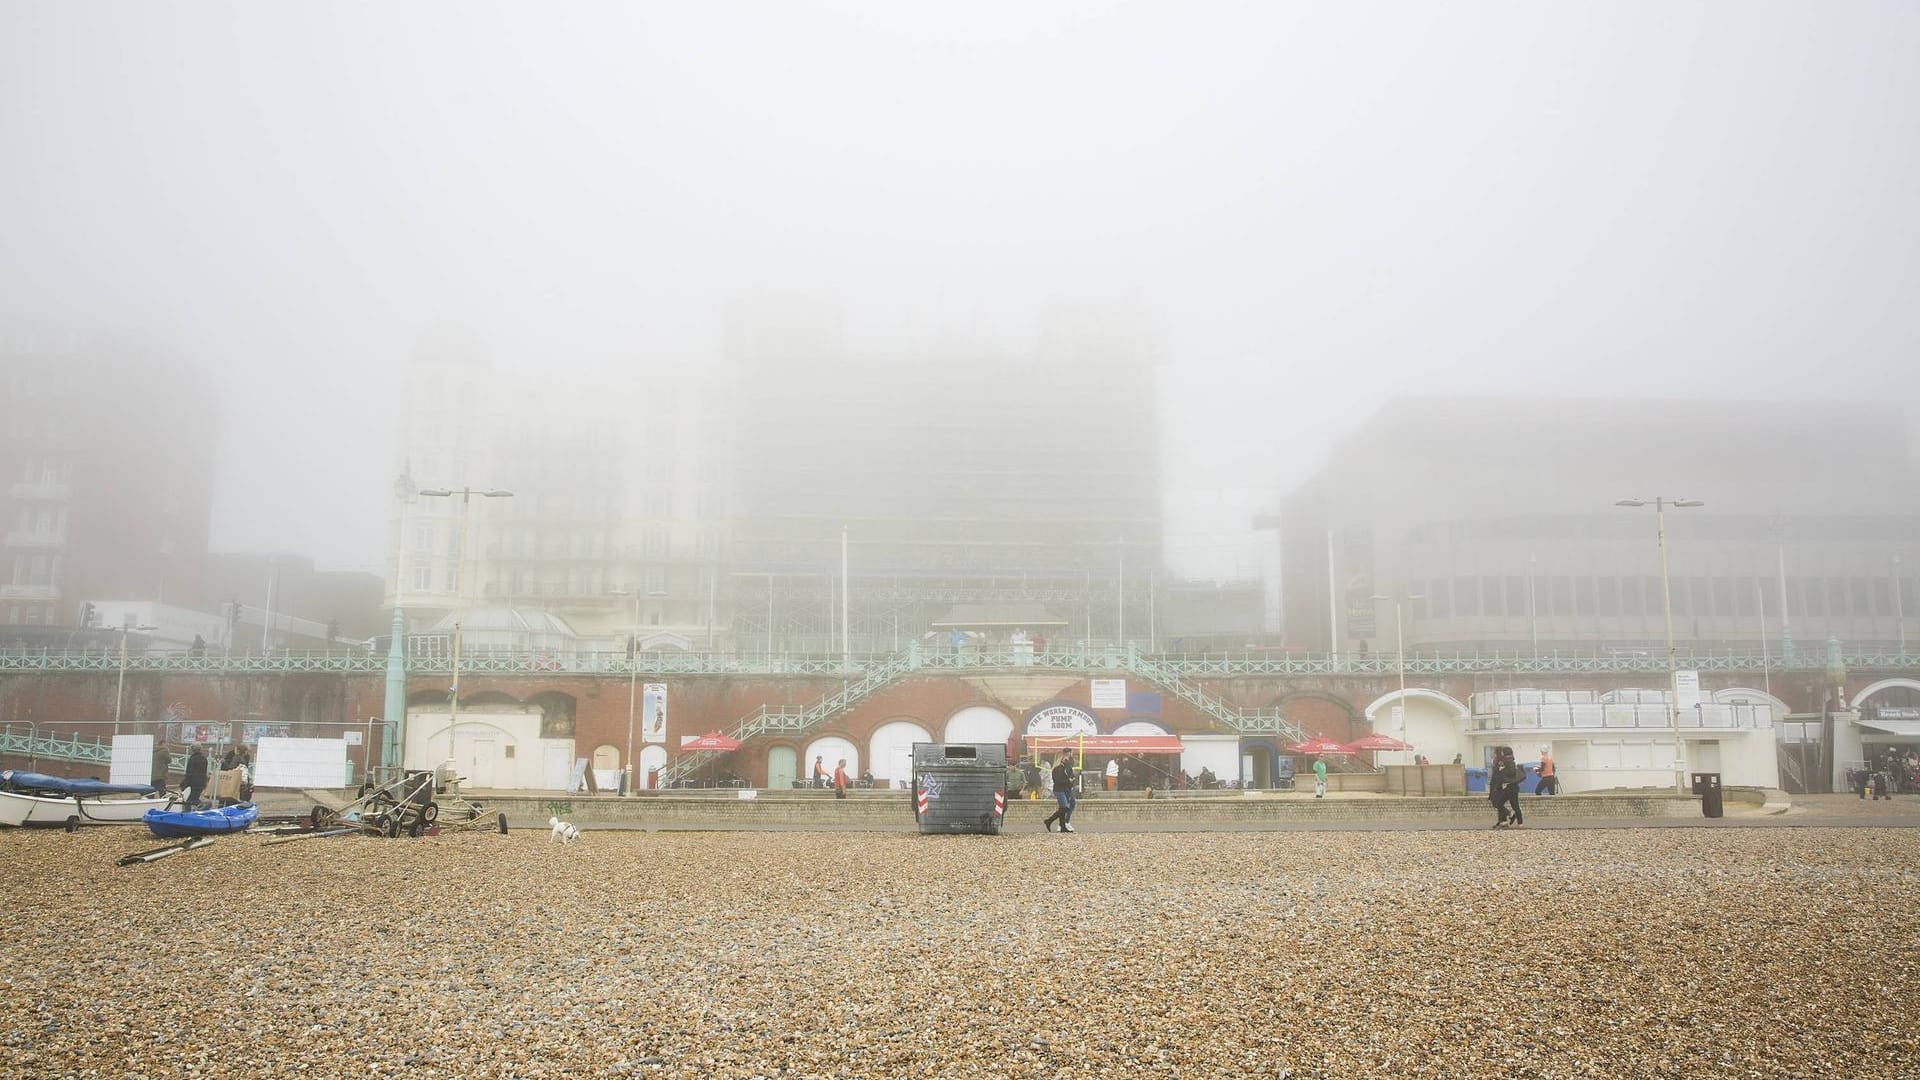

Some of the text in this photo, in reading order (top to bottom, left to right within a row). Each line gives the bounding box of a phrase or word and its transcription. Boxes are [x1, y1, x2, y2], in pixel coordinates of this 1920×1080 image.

[1030, 708, 1094, 727] THE WORLD FAMOUS
